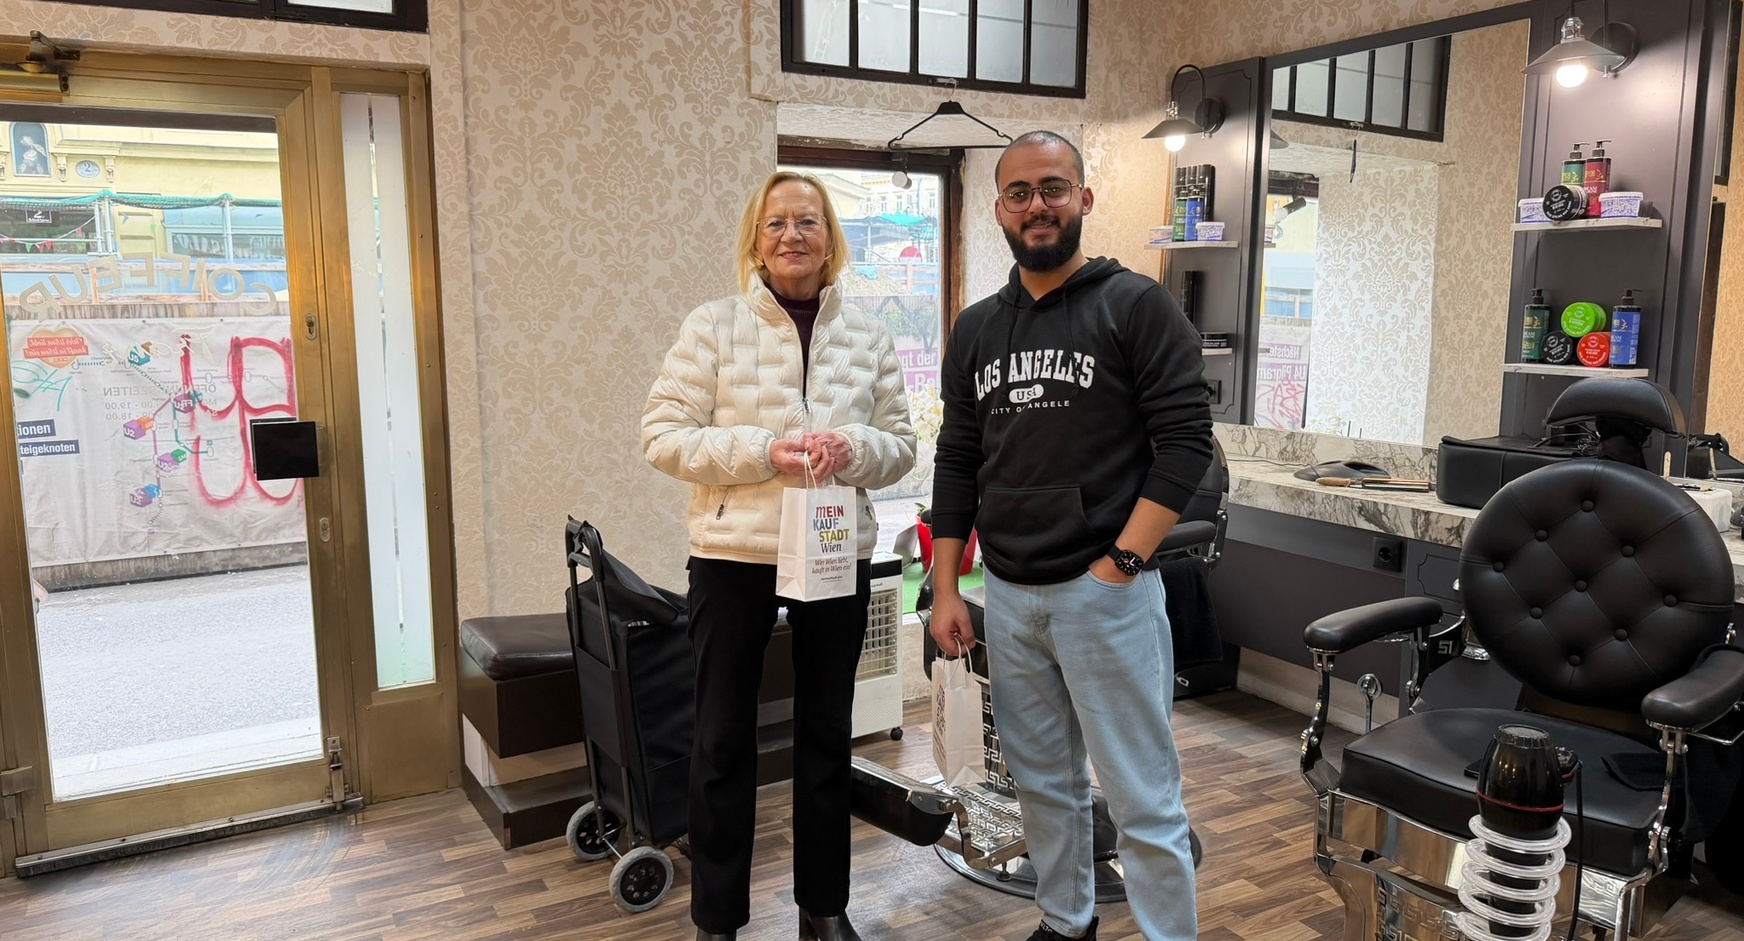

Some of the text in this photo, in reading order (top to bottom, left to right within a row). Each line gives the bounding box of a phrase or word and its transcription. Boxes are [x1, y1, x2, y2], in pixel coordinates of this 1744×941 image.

[916, 350, 937, 367] der
[974, 349, 1095, 401] LOS ANGELES
[124, 428, 135, 437] U2
[20, 442, 76, 456] teigeknoten
[813, 518, 839, 531] KAUF
[819, 528, 849, 542] STADT
[821, 542, 842, 553] Wien
[812, 567, 824, 575] kauft
[831, 564, 842, 572] Wien
